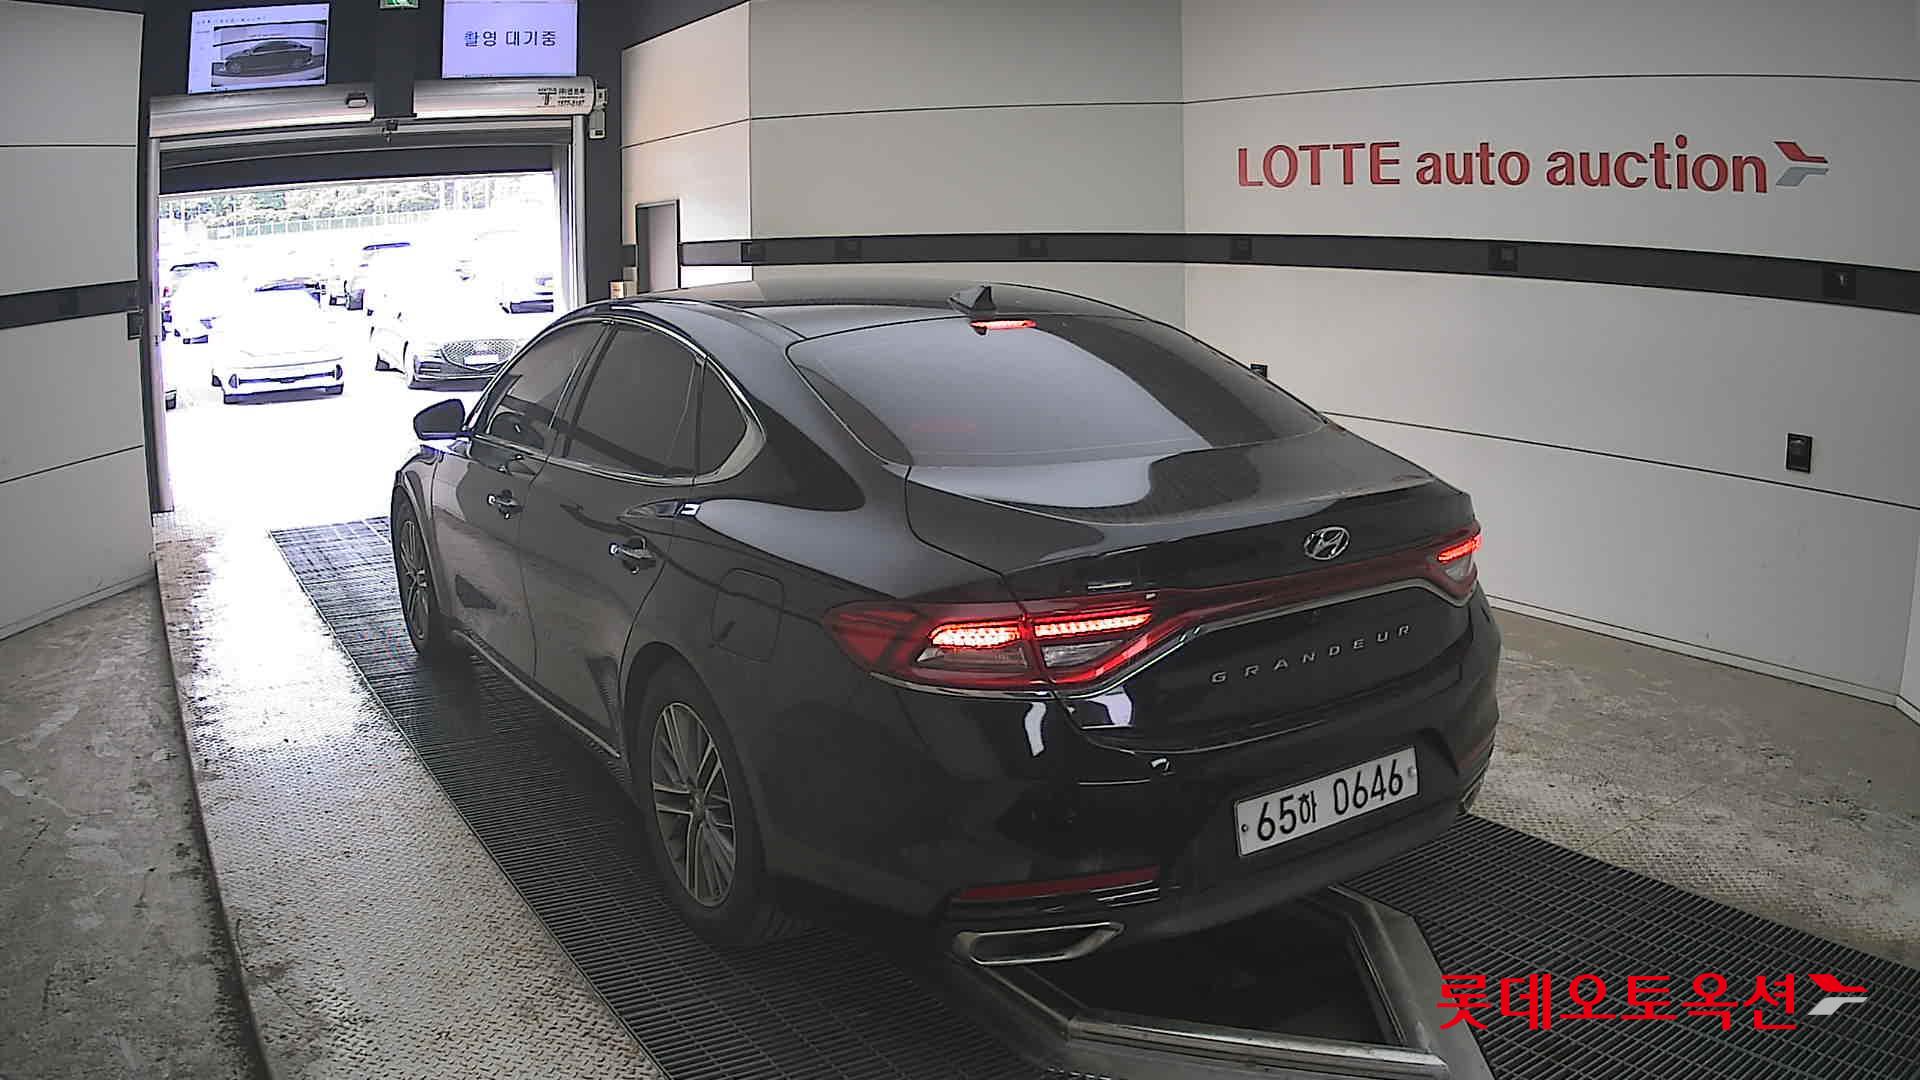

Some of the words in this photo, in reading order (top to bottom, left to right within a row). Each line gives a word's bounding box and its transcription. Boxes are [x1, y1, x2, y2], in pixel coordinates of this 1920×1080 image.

[505, 29, 557, 47] 대기중
[1238, 141, 1401, 188] LOTTE
[1416, 142, 1531, 186] auto
[1546, 134, 1768, 194] auction
[1210, 625, 1410, 684] GRANDEUR
[1257, 790, 1318, 841] 65하
[1332, 759, 1403, 816] 0646
